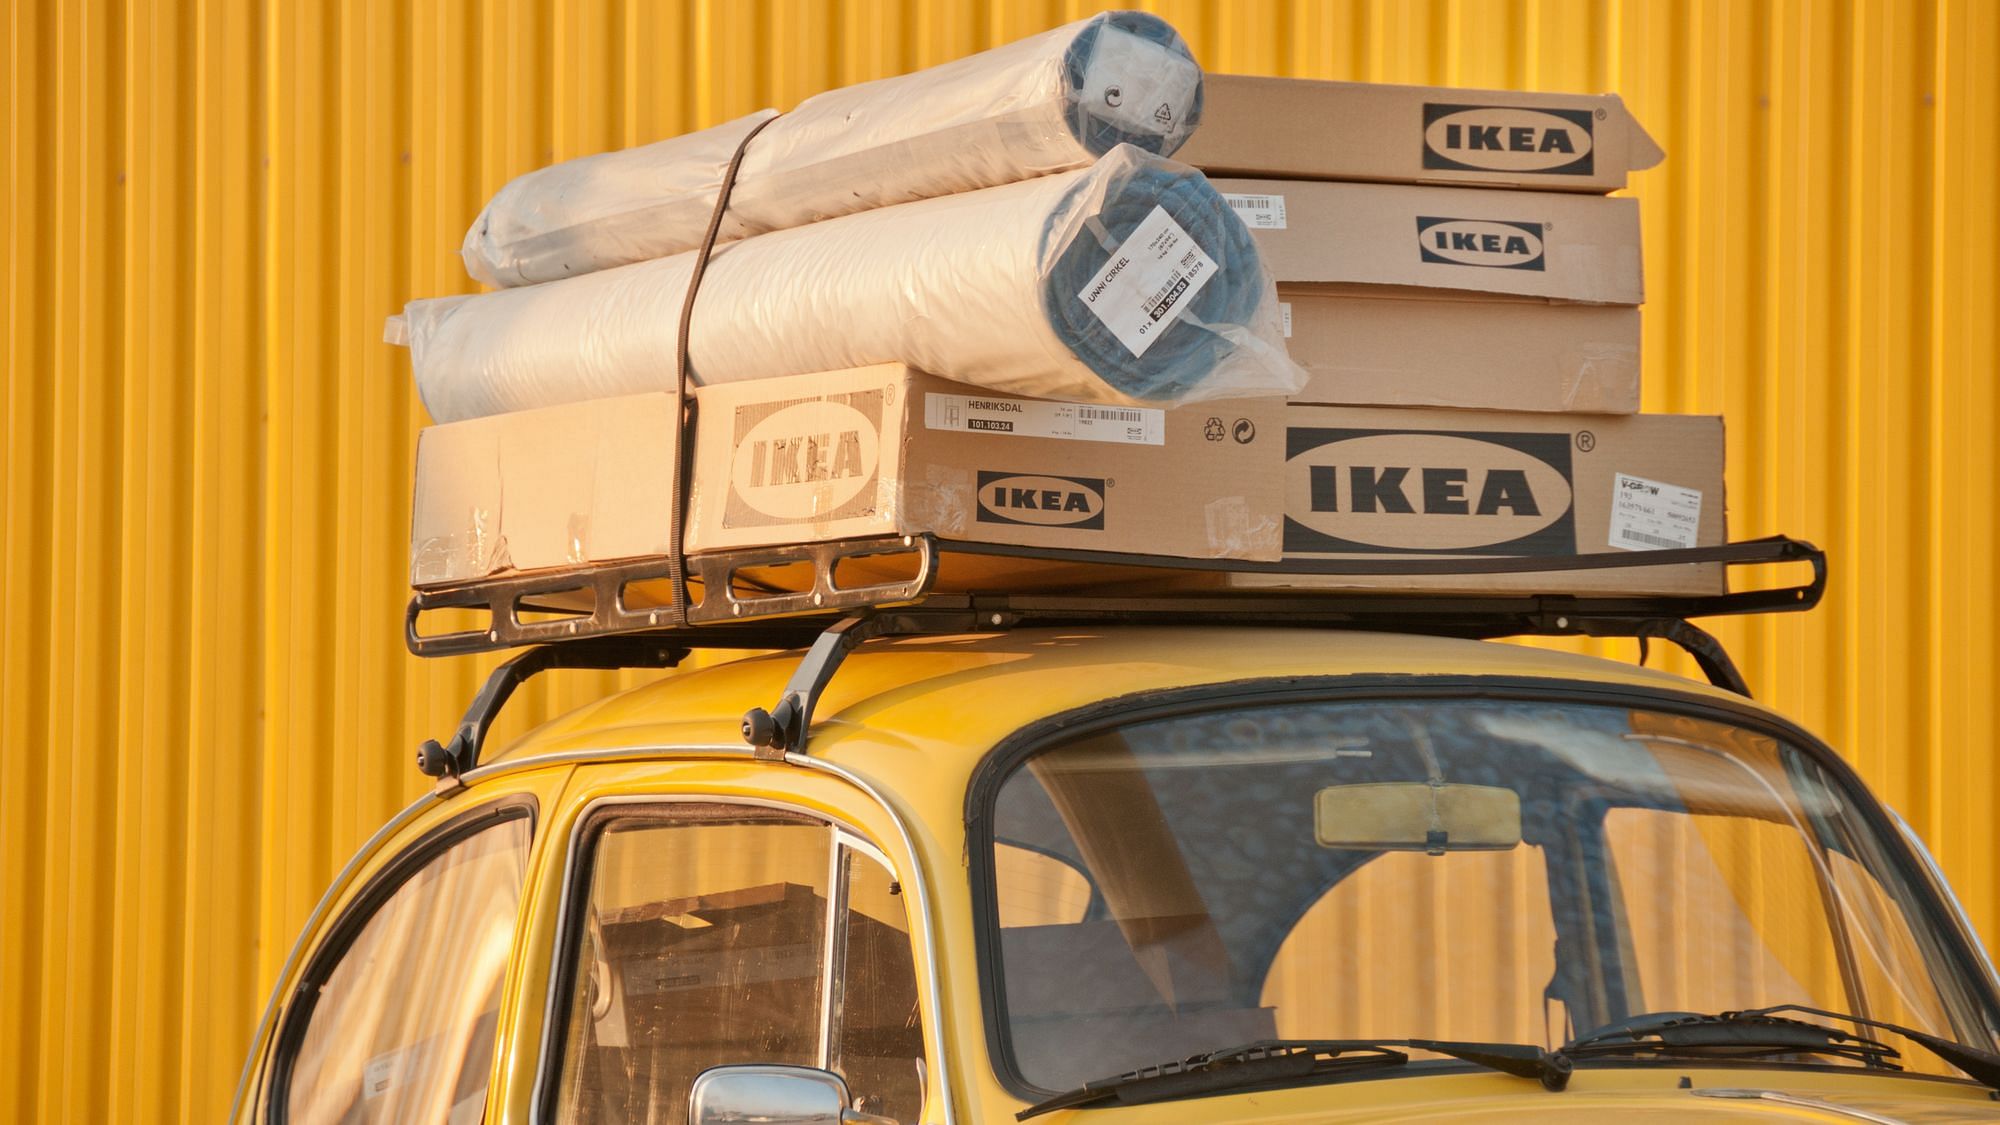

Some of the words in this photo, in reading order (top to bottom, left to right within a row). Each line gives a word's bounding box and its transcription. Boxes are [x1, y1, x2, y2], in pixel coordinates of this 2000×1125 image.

[1446, 124, 1575, 154] IKEA
[1435, 231, 1531, 255] IKEA
[1088, 281, 1107, 303] UNNI
[1105, 257, 1130, 283] CIRKEL
[1153, 281, 1187, 319] 301.204.83
[968, 400, 1023, 413] HENRIKSDAL
[971, 420, 1011, 431] 101.103.24
[750, 431, 864, 487] IKEA
[994, 487, 1090, 513] IKEA
[1310, 465, 1542, 516] IKEA
